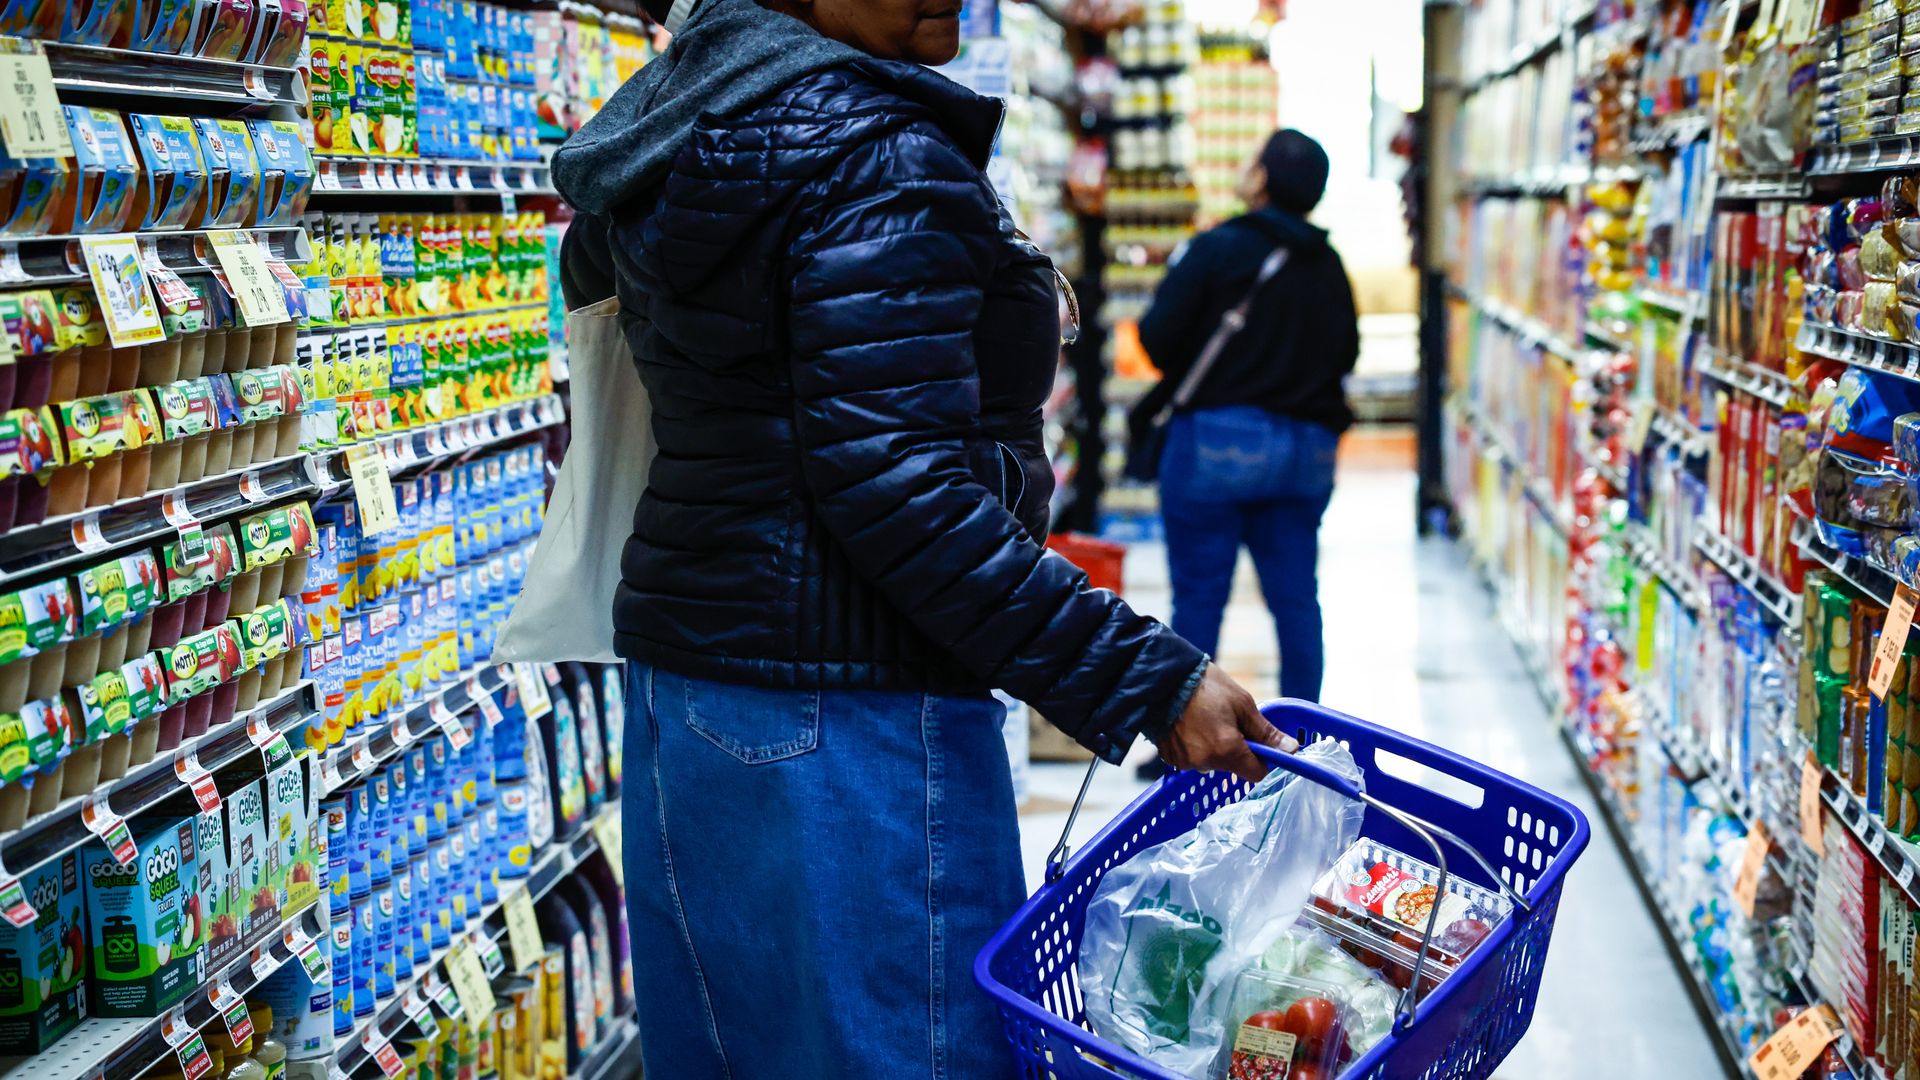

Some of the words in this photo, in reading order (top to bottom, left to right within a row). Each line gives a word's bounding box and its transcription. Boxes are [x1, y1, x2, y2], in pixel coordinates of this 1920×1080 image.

[174, 652, 197, 672] MOTT'S
[146, 845, 178, 883] GOGO
[150, 873, 181, 901] SQUEEZ
[1359, 867, 1400, 907] Campari
